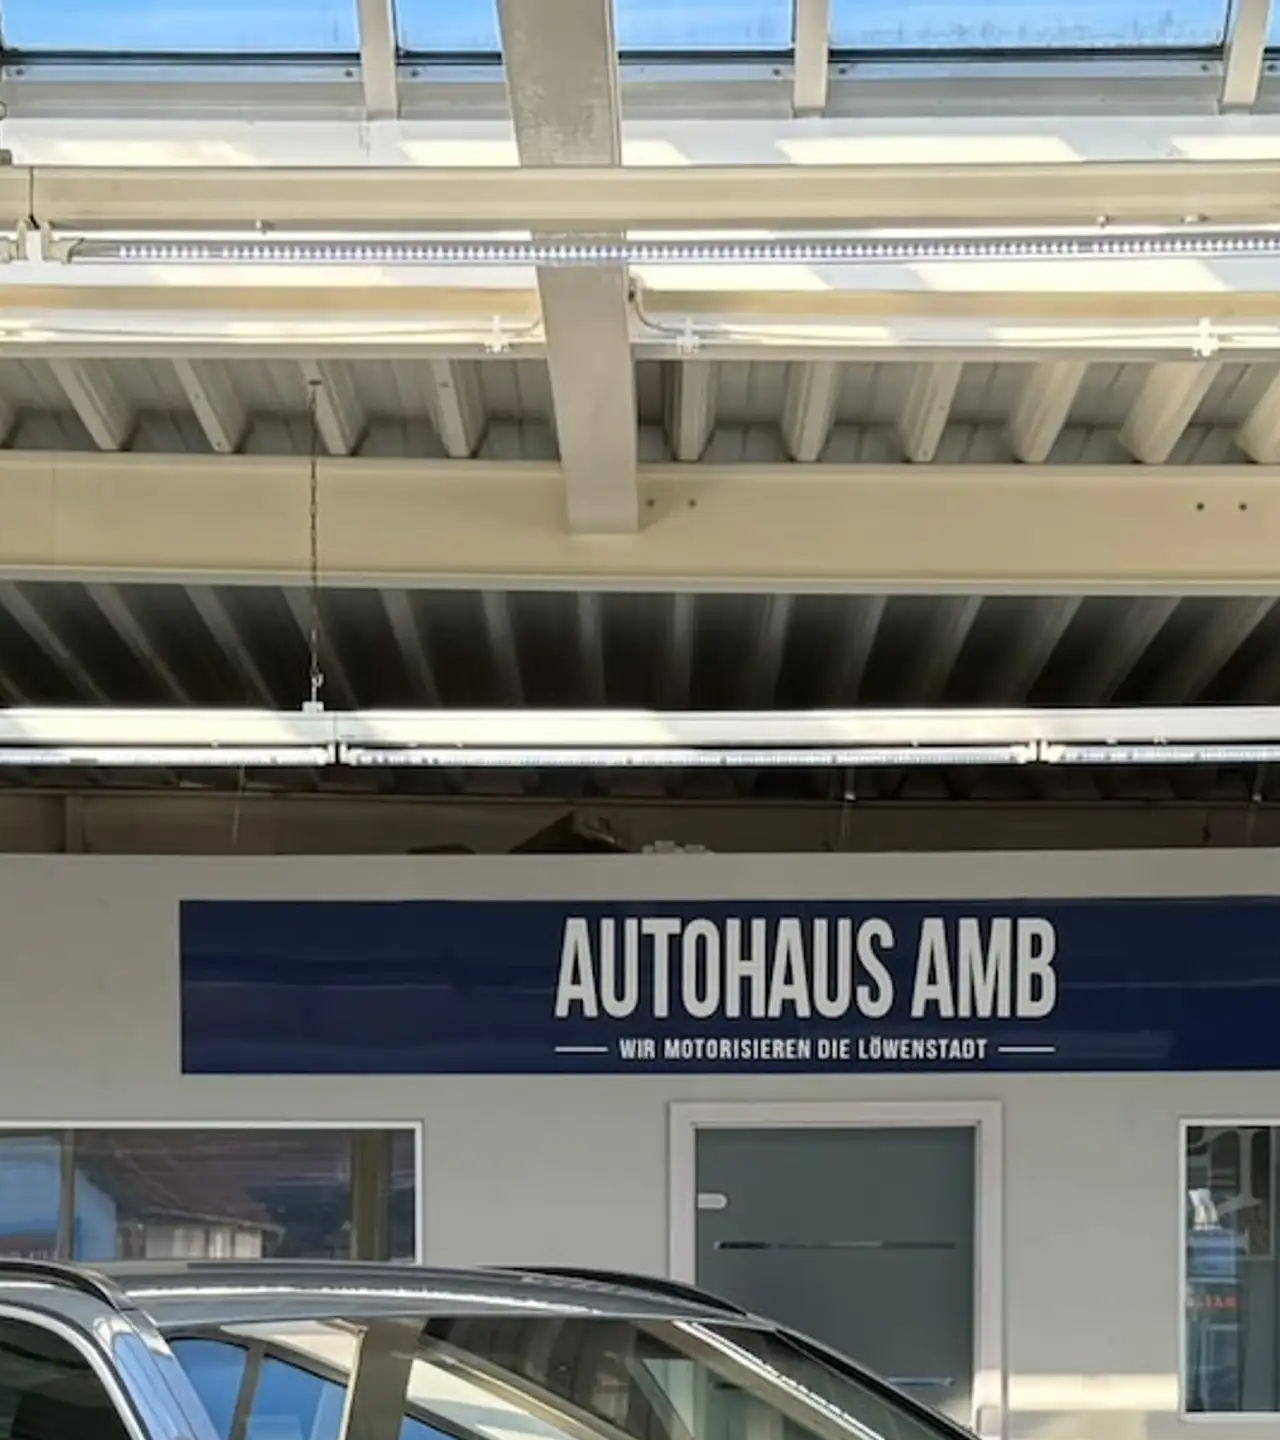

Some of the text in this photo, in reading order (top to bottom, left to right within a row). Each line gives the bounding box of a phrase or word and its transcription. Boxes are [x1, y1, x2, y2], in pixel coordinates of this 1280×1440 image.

[555, 917, 1057, 1018] AUTOHAUS AMB
[619, 1035, 988, 1060] WIR MOTORISIEREN DIE LÖWENSTADT
